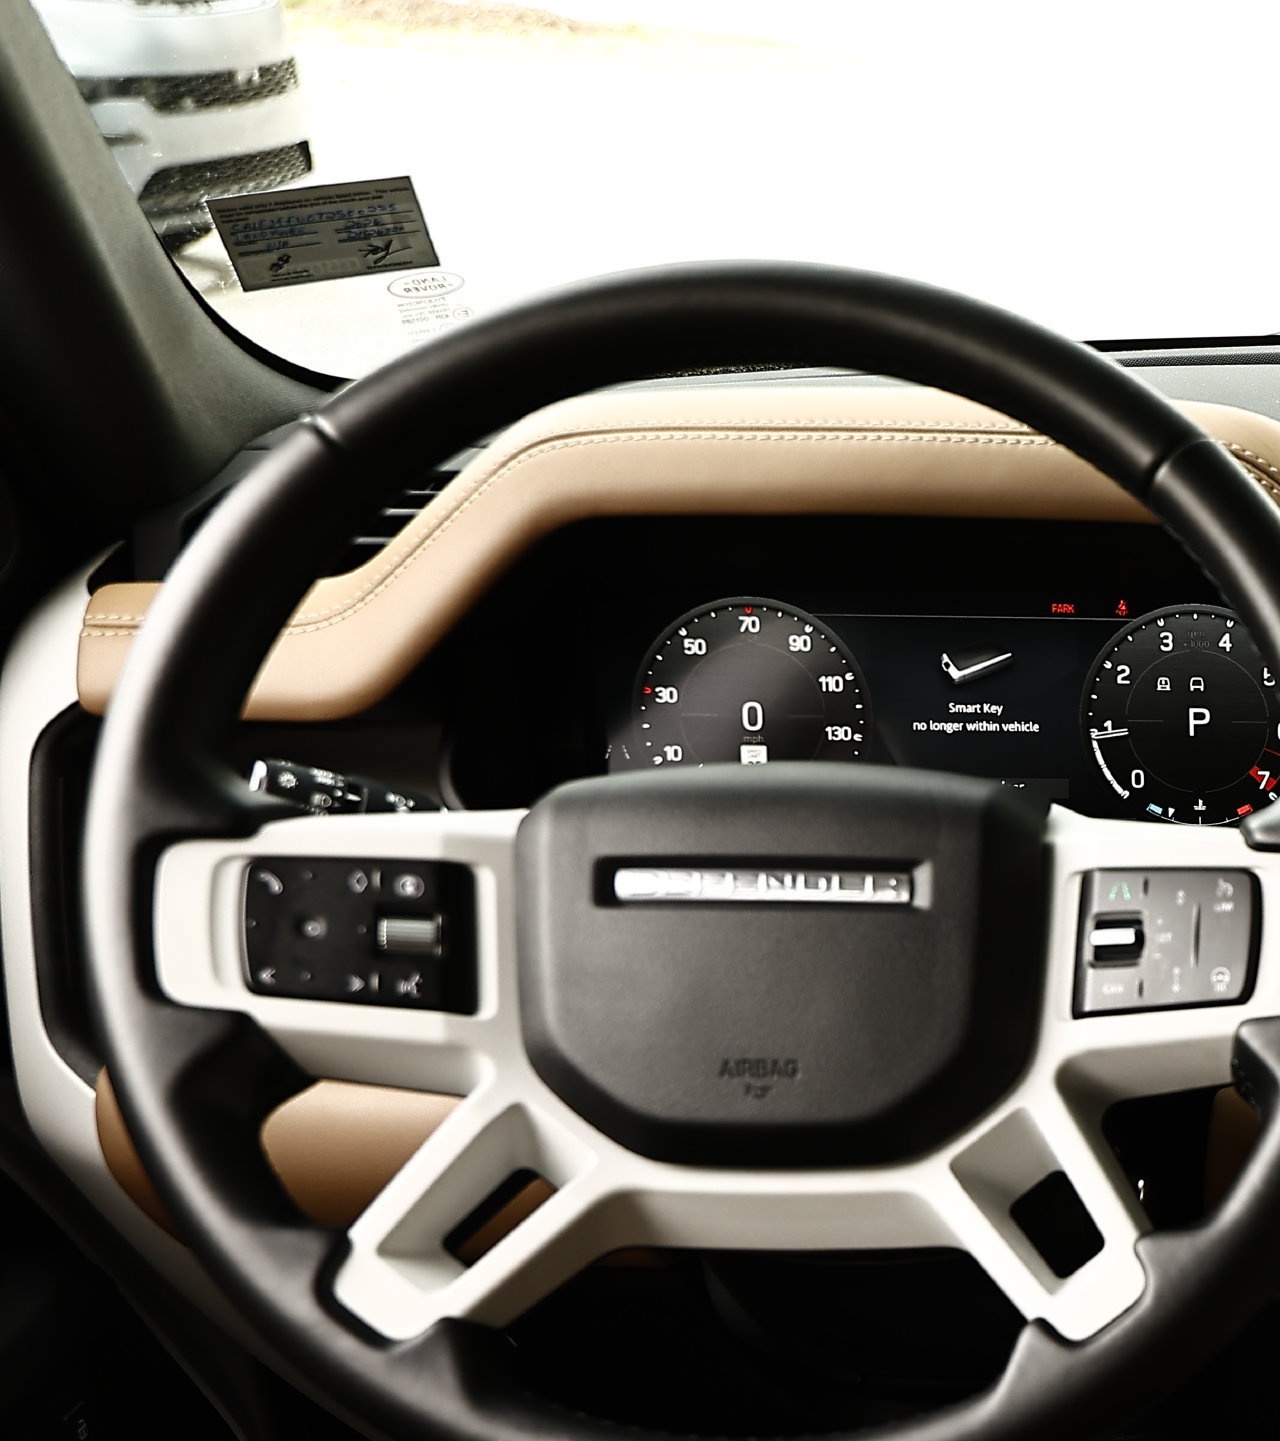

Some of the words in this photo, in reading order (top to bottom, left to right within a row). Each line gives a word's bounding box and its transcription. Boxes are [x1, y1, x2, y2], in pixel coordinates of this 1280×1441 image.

[738, 616, 761, 633] 70
[683, 638, 707, 655] 50
[788, 635, 812, 652] 90
[1159, 631, 1173, 652] 3
[1218, 632, 1233, 652] 4
[1116, 664, 1131, 685] 2
[818, 675, 844, 692] 110
[655, 687, 679, 704] 30
[741, 701, 764, 731] 0
[949, 702, 981, 714] Smart
[983, 703, 1004, 716] Key
[913, 722, 927, 731] no
[929, 720, 964, 734] longer
[966, 721, 999, 732] within
[1001, 721, 1040, 733] vehicle
[1188, 707, 1211, 737] P
[825, 726, 851, 741] 130
[663, 745, 683, 762] 10
[1131, 769, 1145, 789] 0
[1257, 770, 1271, 790] 7
